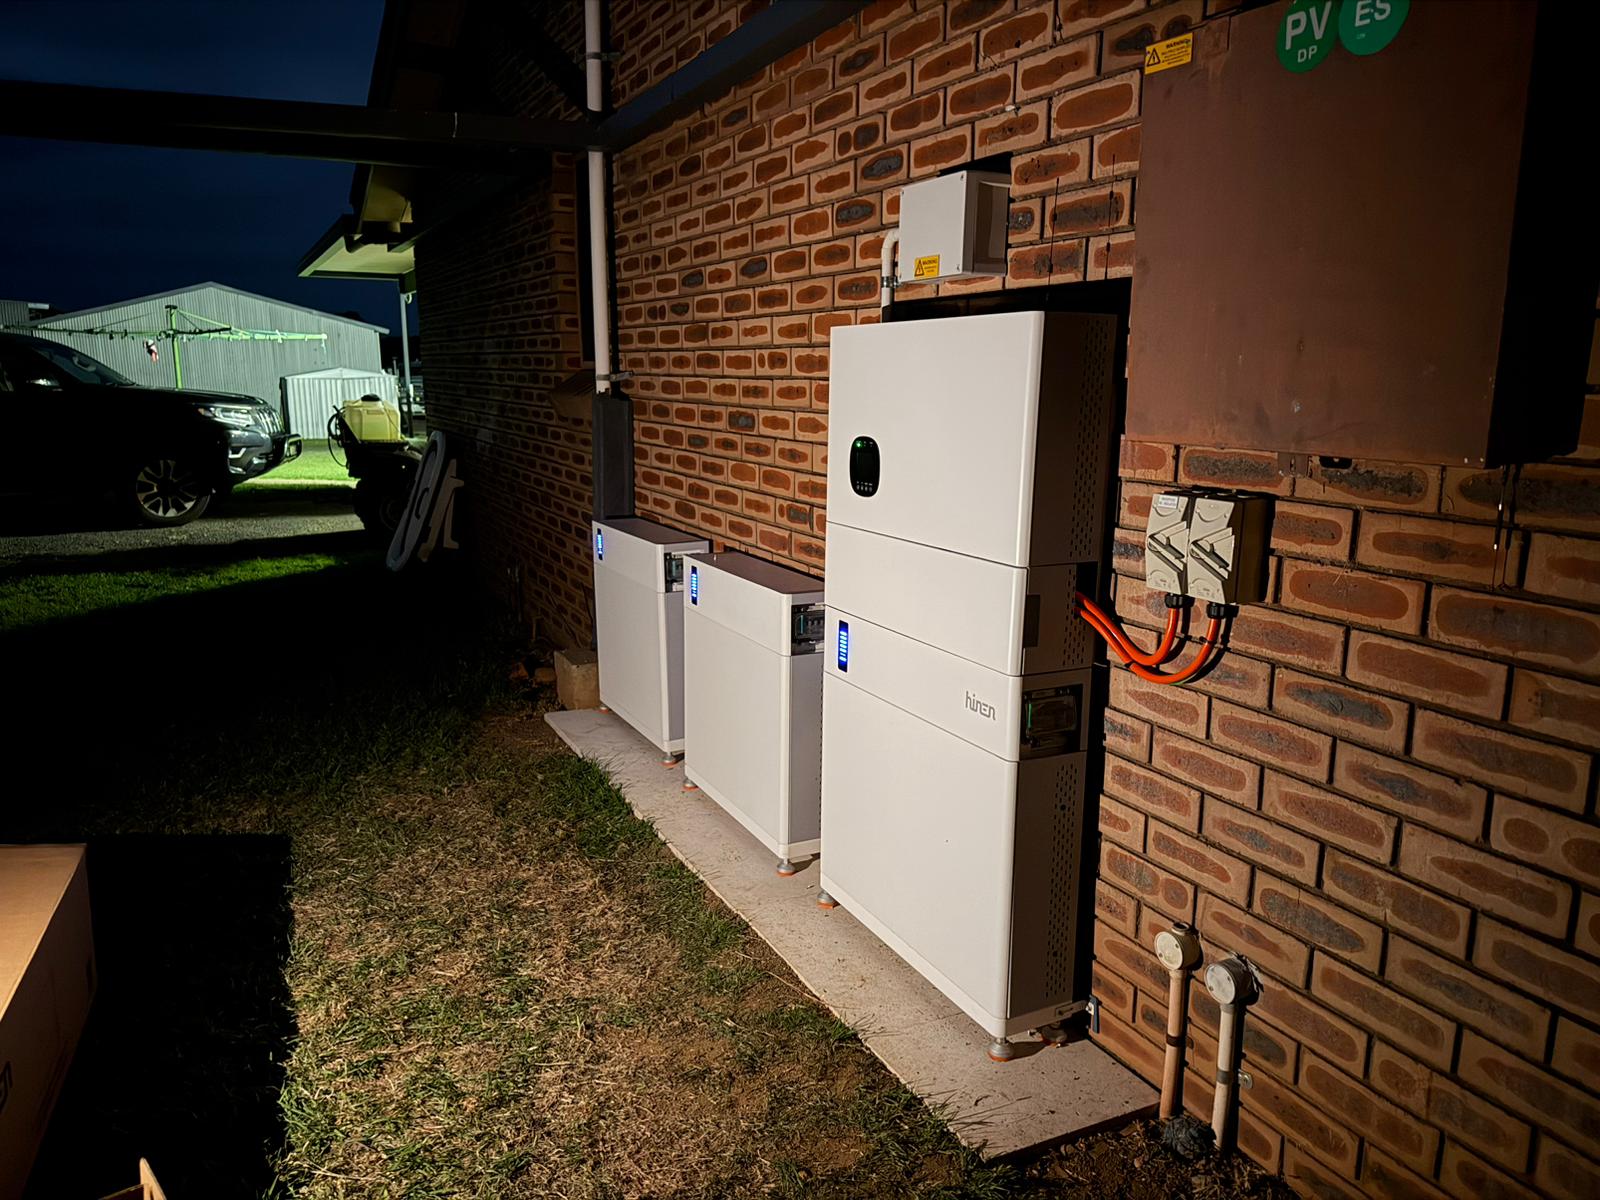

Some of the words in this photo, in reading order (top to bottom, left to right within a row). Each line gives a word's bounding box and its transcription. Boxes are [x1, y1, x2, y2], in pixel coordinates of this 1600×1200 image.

[1285, 1, 1332, 50] PV
[1355, 0, 1391, 27] ES
[1297, 45, 1318, 63] DP
